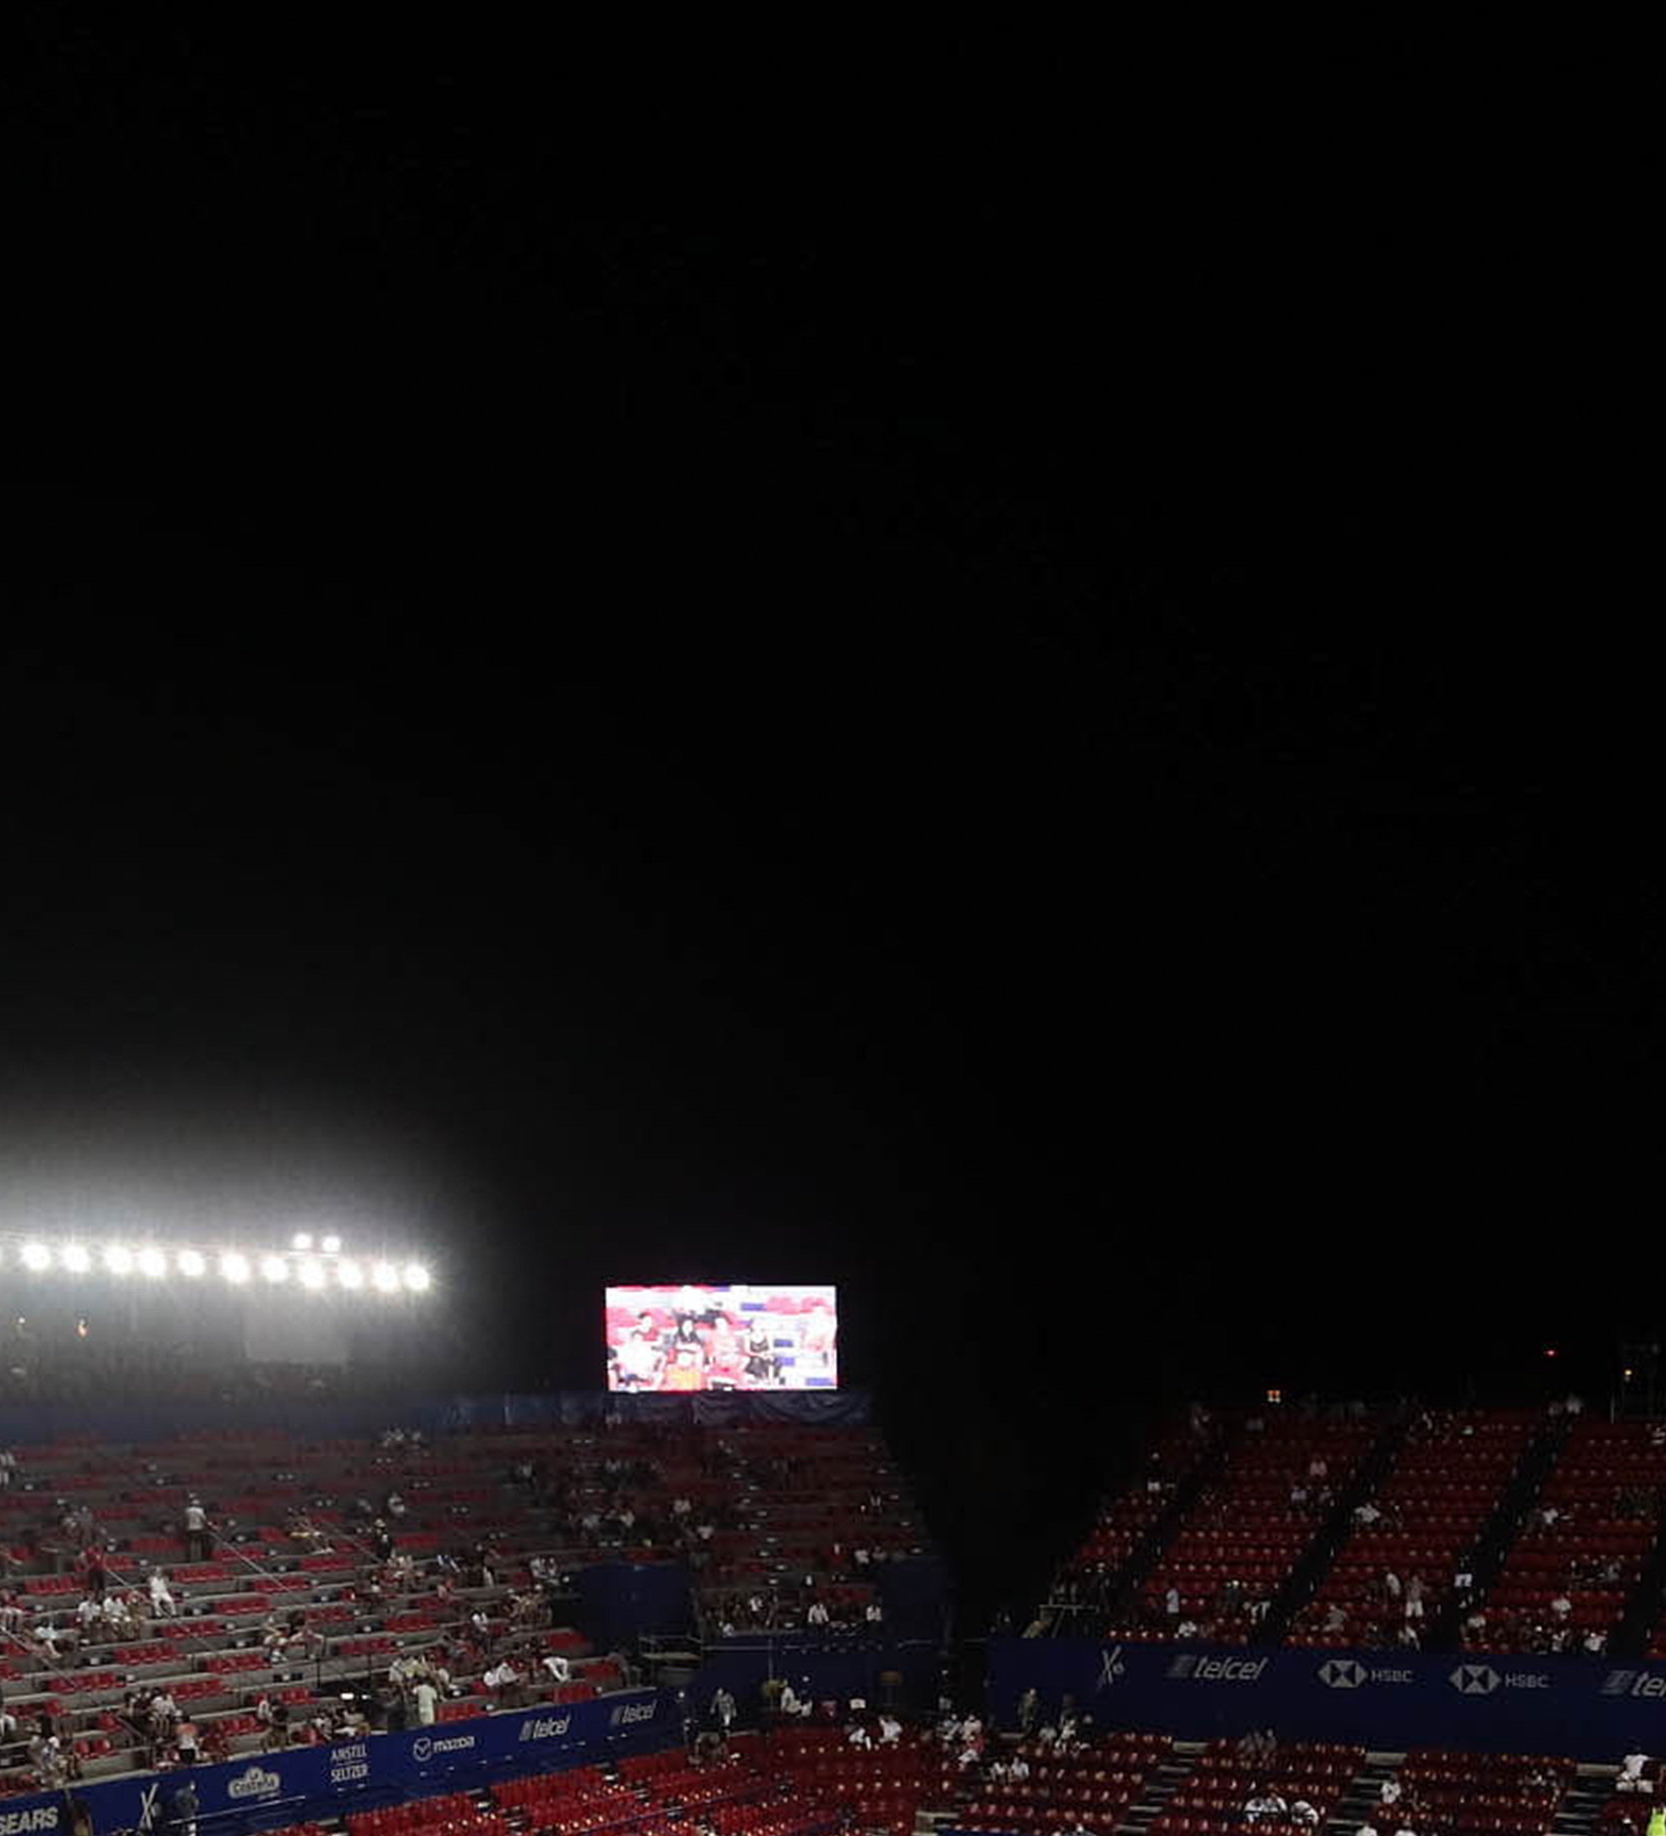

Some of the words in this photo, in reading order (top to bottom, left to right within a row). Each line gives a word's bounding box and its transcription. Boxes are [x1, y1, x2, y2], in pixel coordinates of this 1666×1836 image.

[1194, 1656, 1268, 1681] telcel
[1371, 1670, 1413, 1683] HSBC
[1504, 1672, 1550, 1689] HSBC
[621, 1700, 658, 1724] telcel
[533, 1712, 572, 1739] telcel
